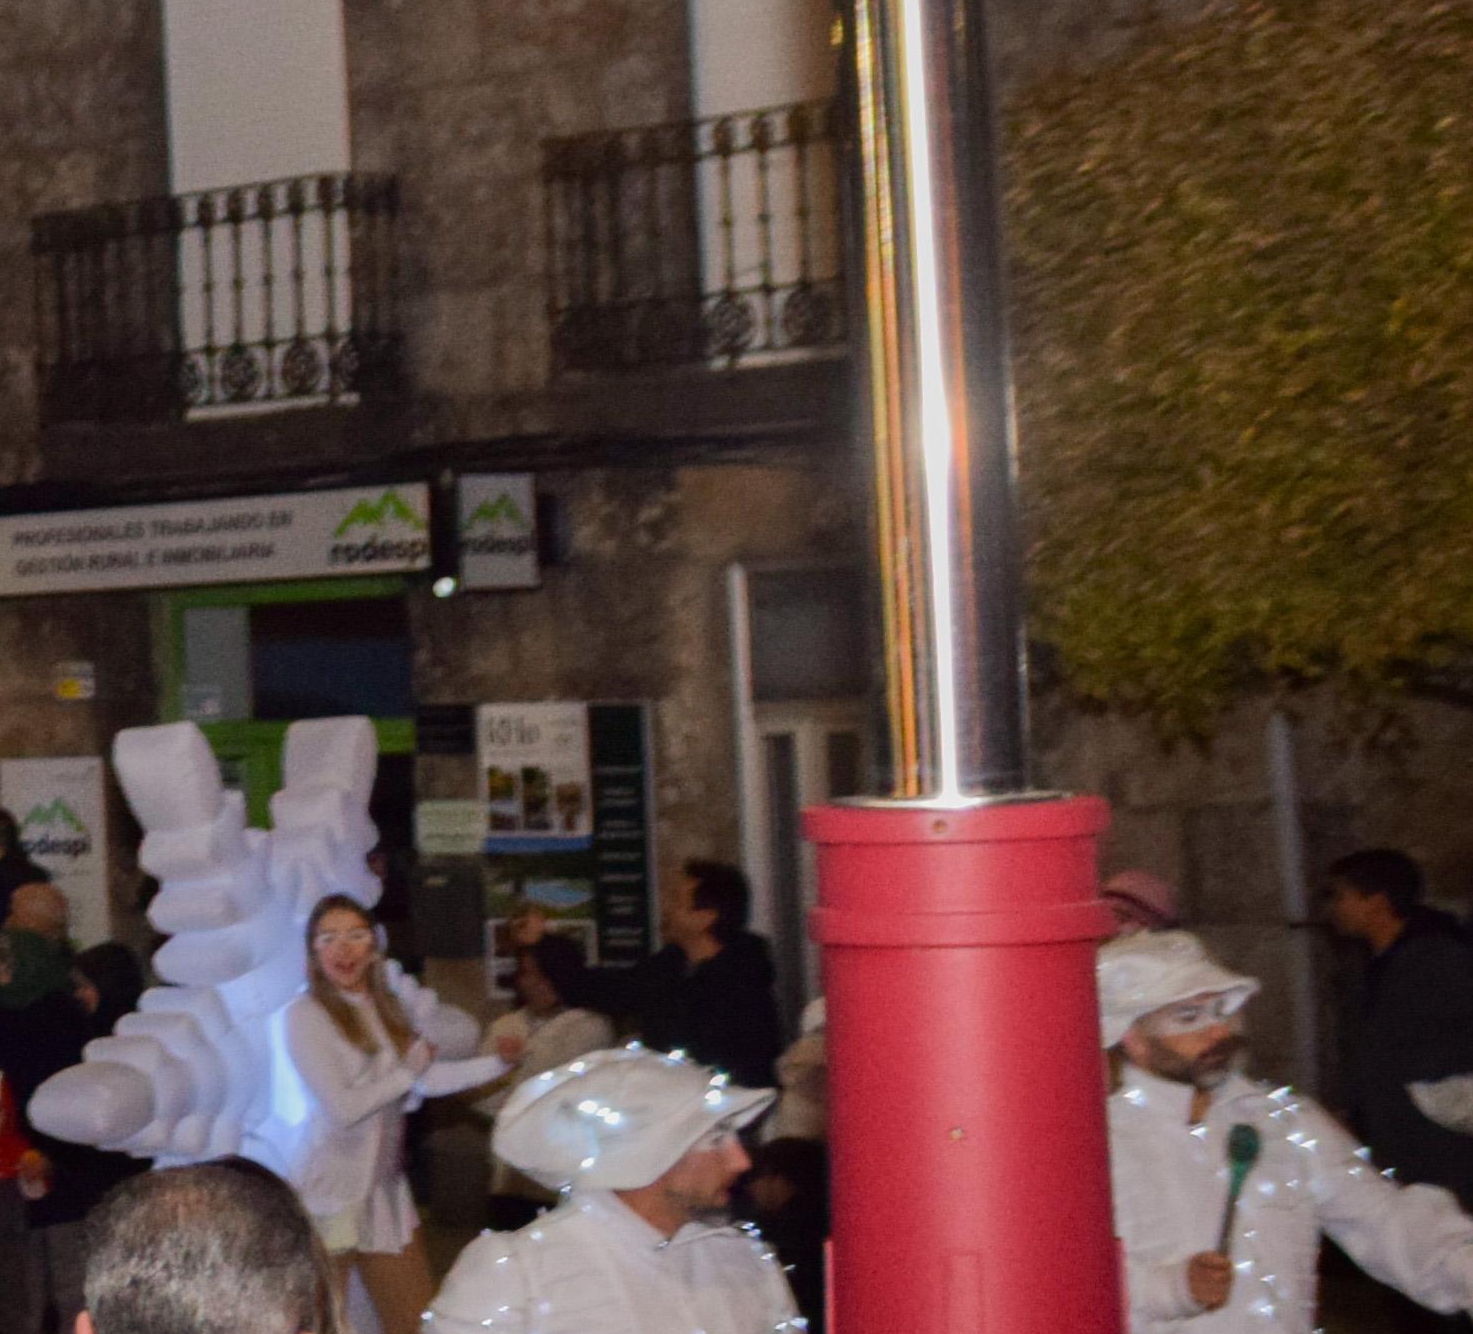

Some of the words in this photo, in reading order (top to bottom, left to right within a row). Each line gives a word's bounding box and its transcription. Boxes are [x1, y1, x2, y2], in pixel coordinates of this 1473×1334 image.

[12, 521, 145, 547] PROFESIONALES
[149, 513, 265, 536] TRABAJANDO
[161, 542, 276, 566] INMOBILIARIA
